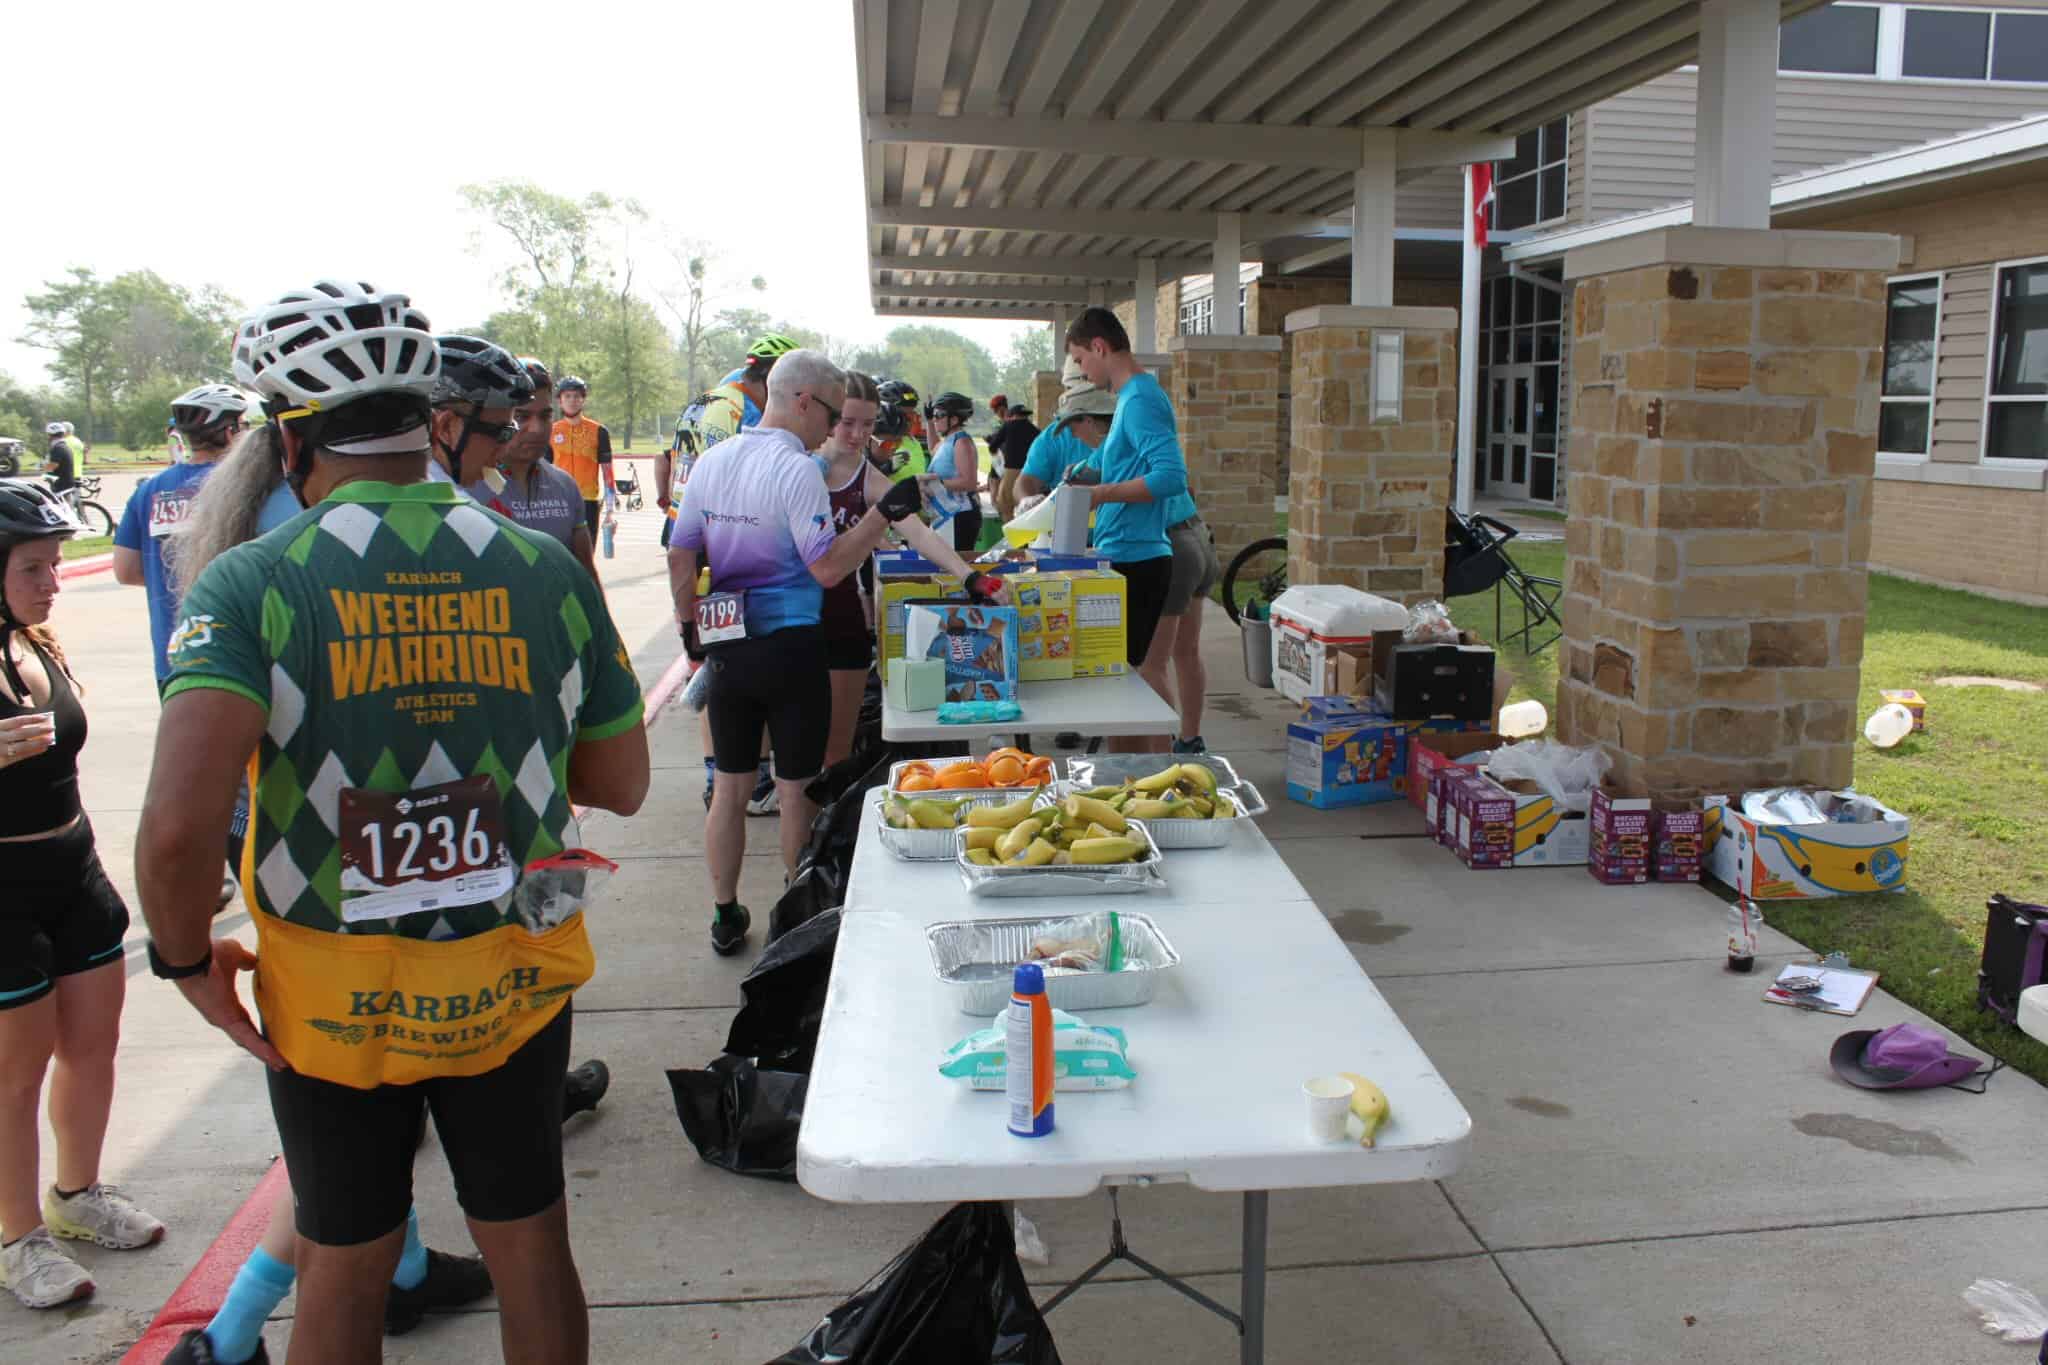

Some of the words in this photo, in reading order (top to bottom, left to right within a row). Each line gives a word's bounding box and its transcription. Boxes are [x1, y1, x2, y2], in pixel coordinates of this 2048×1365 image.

[329, 587, 511, 636] WEEKEND
[699, 599, 737, 628] 2199
[327, 633, 534, 701] WARRIOR
[394, 692, 477, 710] ATHLETICS
[361, 807, 489, 879] 1236
[349, 967, 543, 1022] KARBACH
[372, 1015, 503, 1044] BREWING
